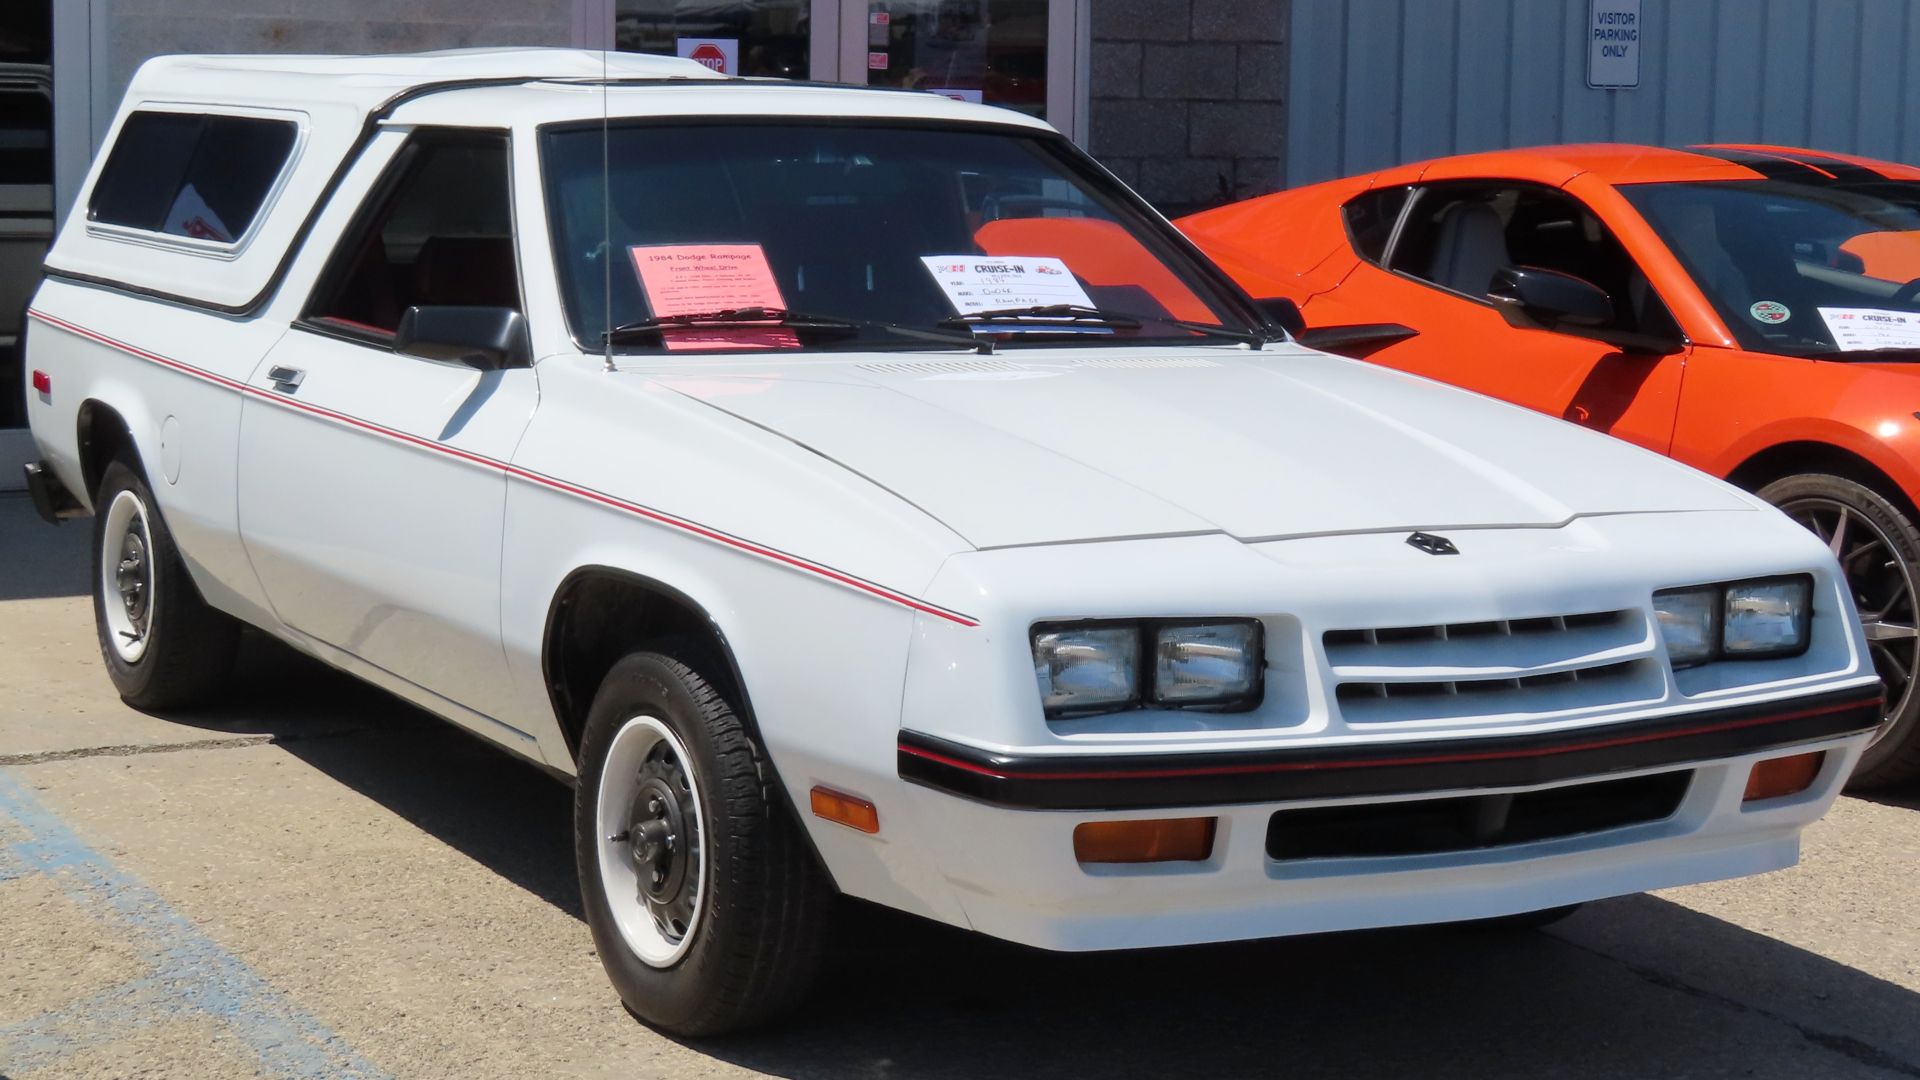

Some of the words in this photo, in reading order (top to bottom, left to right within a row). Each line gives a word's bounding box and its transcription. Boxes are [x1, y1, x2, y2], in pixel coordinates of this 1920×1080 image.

[1598, 12, 1636, 25] VISITOR
[1594, 28, 1638, 41] PARKING
[1602, 45, 1628, 57] ONLY
[695, 58, 723, 73] TOP
[648, 254, 673, 262] 1984
[710, 253, 752, 261] Rampage
[975, 265, 1025, 273] CRUISE-IN
[1862, 315, 1906, 323] CRUISE-IN
